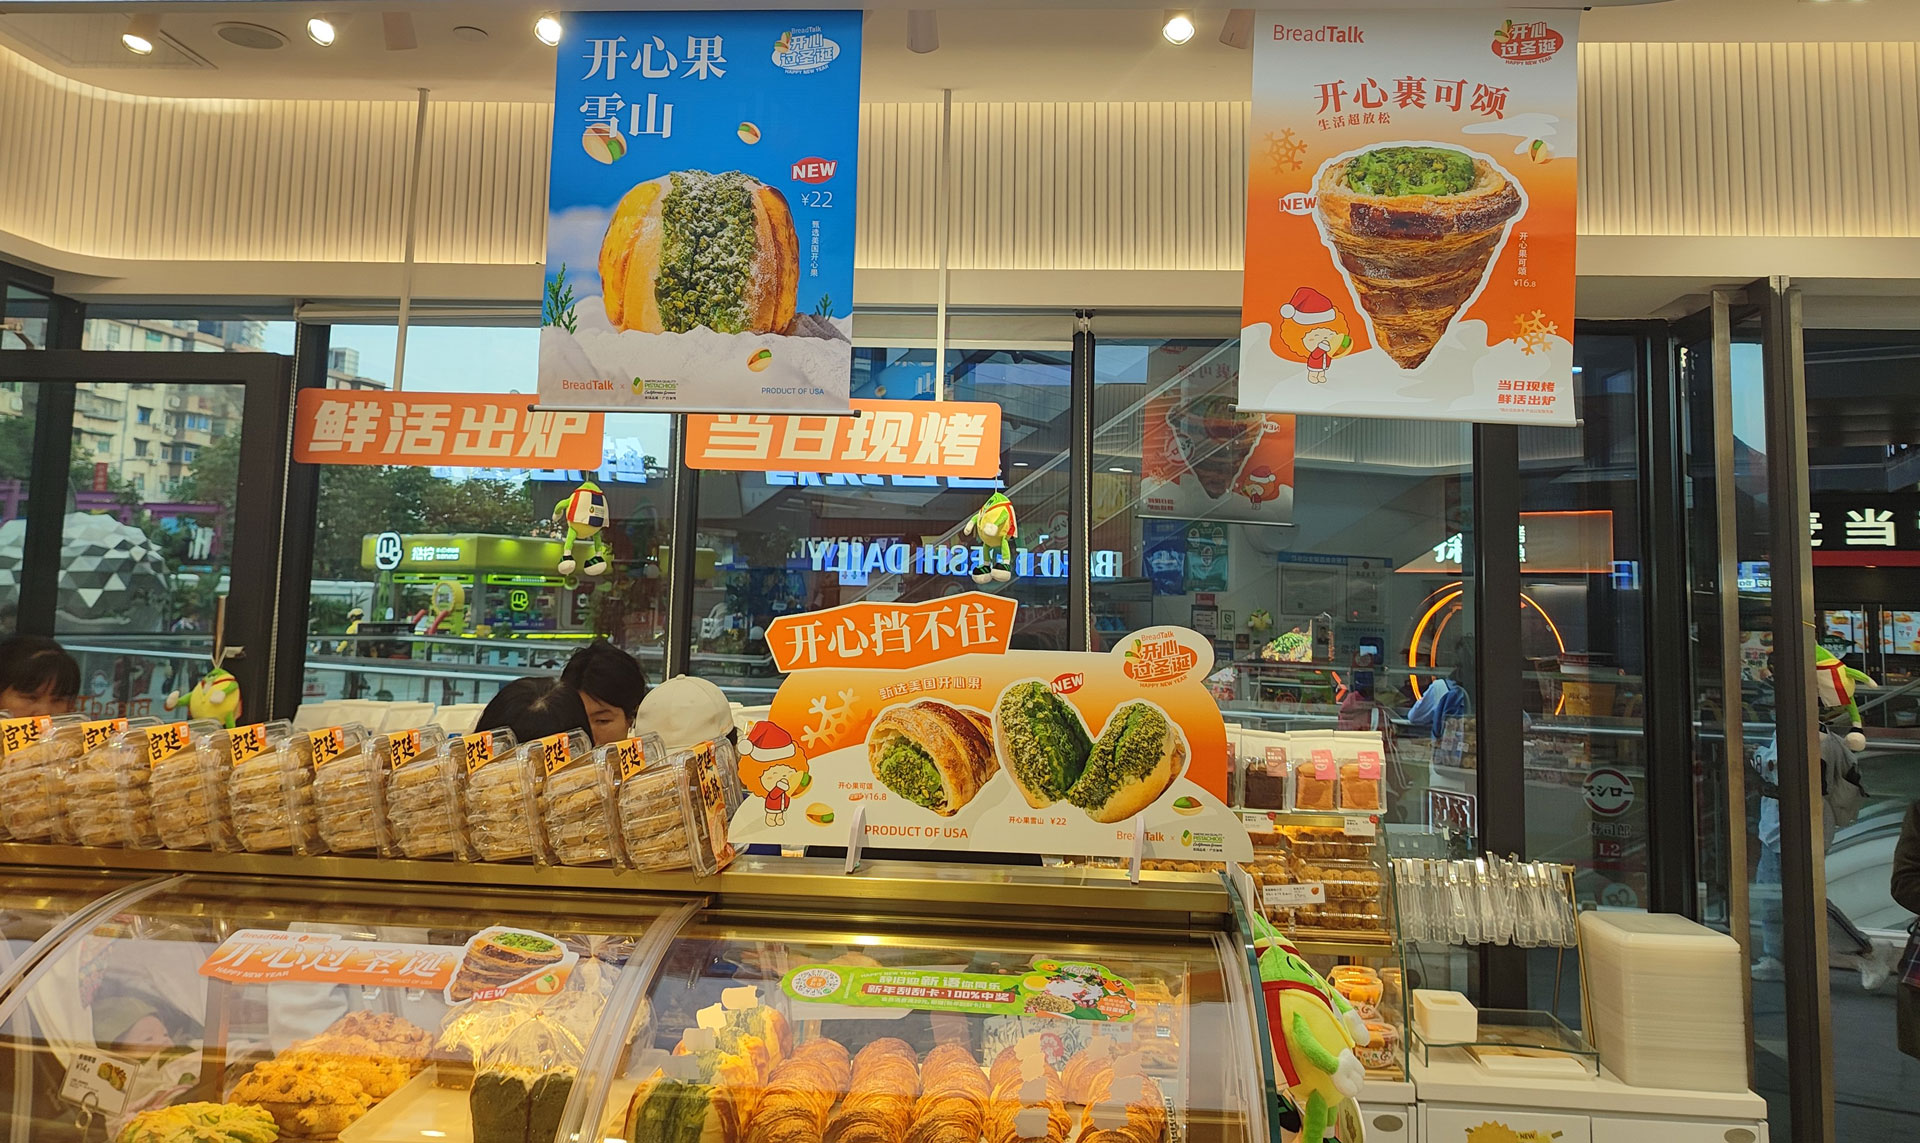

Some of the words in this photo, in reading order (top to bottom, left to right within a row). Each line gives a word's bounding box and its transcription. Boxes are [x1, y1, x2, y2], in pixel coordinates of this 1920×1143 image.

[791, 26, 822, 34] BreadTalk
[1273, 24, 1364, 44] BreadTalk
[1511, 22, 1547, 40] 开心
[790, 33, 823, 50] 开心
[1500, 38, 1556, 57] 过圣诞
[581, 34, 728, 81] 开心果
[780, 47, 833, 67] 过圣诞
[1314, 75, 1511, 120] 开心裹可颂
[580, 92, 674, 139] 雪山
[1317, 111, 1392, 132] 生活超放松
[791, 161, 837, 180] NEW
[800, 190, 834, 208] ¥22
[1279, 196, 1317, 211] NEW
[1517, 231, 1529, 276] 开心果可颂
[1513, 279, 1537, 288] ¥16.8
[562, 379, 614, 391] BreadTalk
[761, 387, 796, 395] PRODUCT
[797, 387, 806, 395] OF
[807, 387, 825, 396] USA
[1497, 380, 1556, 392] 当日现烤
[1497, 394, 1556, 406] 鲜活出炉
[308, 400, 592, 458] 鲜活出炉
[702, 412, 988, 466] 当日现烤
[785, 602, 1000, 666] 开心挡不住
[1140, 631, 1175, 642] BreadTalk
[1142, 639, 1178, 661] 开心
[1133, 655, 1191, 680] 过圣诞
[878, 676, 982, 701] 甄选美国开心果
[1051, 673, 1084, 694] NEW
[151, 730, 183, 762] 宫廷
[232, 732, 259, 764] 宫廷
[314, 733, 339, 764] 宫廷
[391, 734, 416, 769] 宫廷
[466, 735, 490, 769] 宫廷
[544, 738, 564, 773] 宫廷
[620, 738, 642, 774] 宫廷
[864, 792, 887, 801] ¥16.8
[1582, 785, 1635, 797] スシロー
[1008, 815, 1045, 826] 开心果雪山
[1050, 817, 1067, 826] ¥22
[864, 824, 921, 837] PRODUCT
[924, 827, 940, 838] OF
[943, 827, 969, 839] USA
[1116, 830, 1165, 842] BreaTalk
[241, 932, 289, 941] BreadTalk
[214, 941, 453, 977] 开心过圣诞
[215, 966, 242, 978] HAPPY
[265, 970, 289, 978] YEAR
[472, 988, 508, 1000] NEW
[1519, 1132, 1535, 1140] NEW
